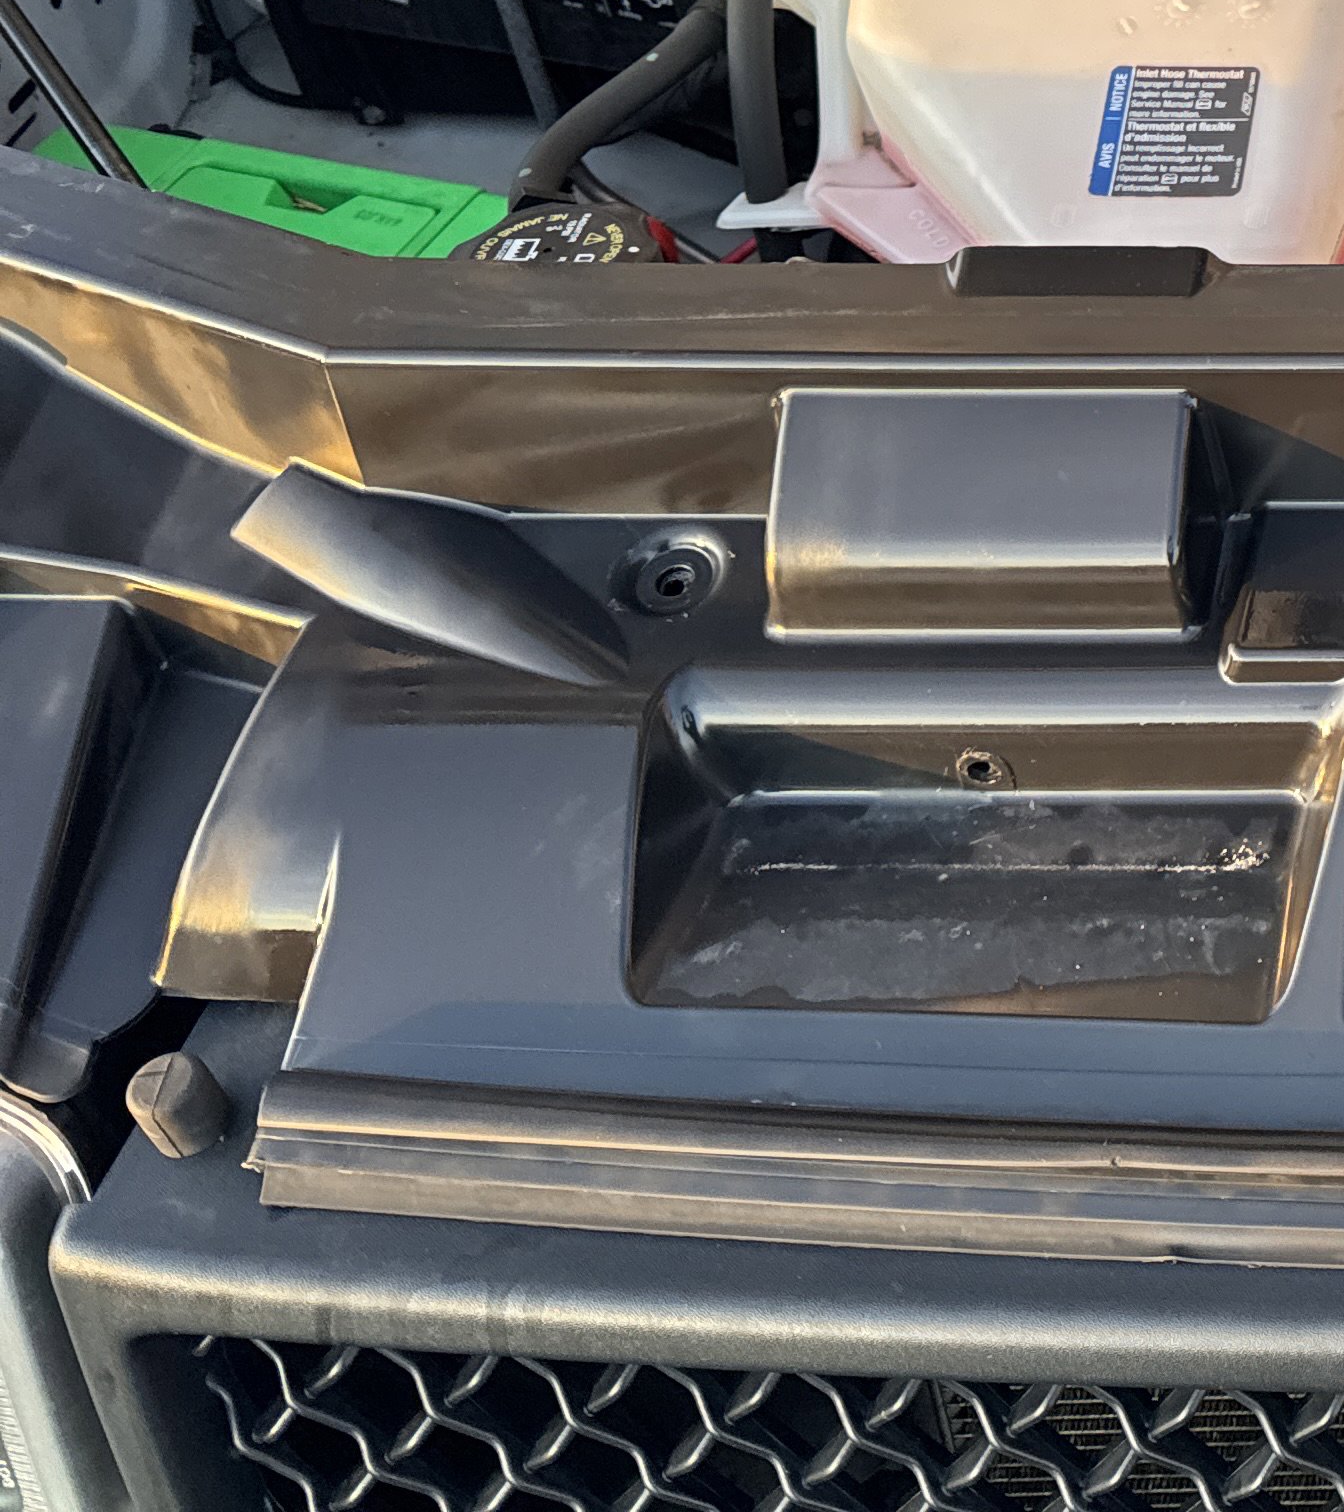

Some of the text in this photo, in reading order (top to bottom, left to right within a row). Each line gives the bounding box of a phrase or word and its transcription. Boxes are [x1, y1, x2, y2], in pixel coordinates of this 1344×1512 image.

[1136, 69, 1244, 79] Inlet Hose Thermostat
[1134, 80, 1171, 89] Improper
[1109, 73, 1128, 111] NOTICE
[1132, 90, 1215, 99] engine damage. See
[1163, 100, 1193, 108] Manual
[1214, 100, 1227, 108] for
[1152, 110, 1200, 118] information.
[1127, 122, 1236, 131] Thermostat et flexible
[1124, 134, 1187, 142] d'admission
[1098, 143, 1115, 168] AVIS
[1118, 164, 1158, 172] Consulter
[1180, 175, 1200, 183] pour
[1201, 175, 1219, 183] plus
[497, 216, 545, 238] JAMAIS
[908, 209, 950, 248] COLD
